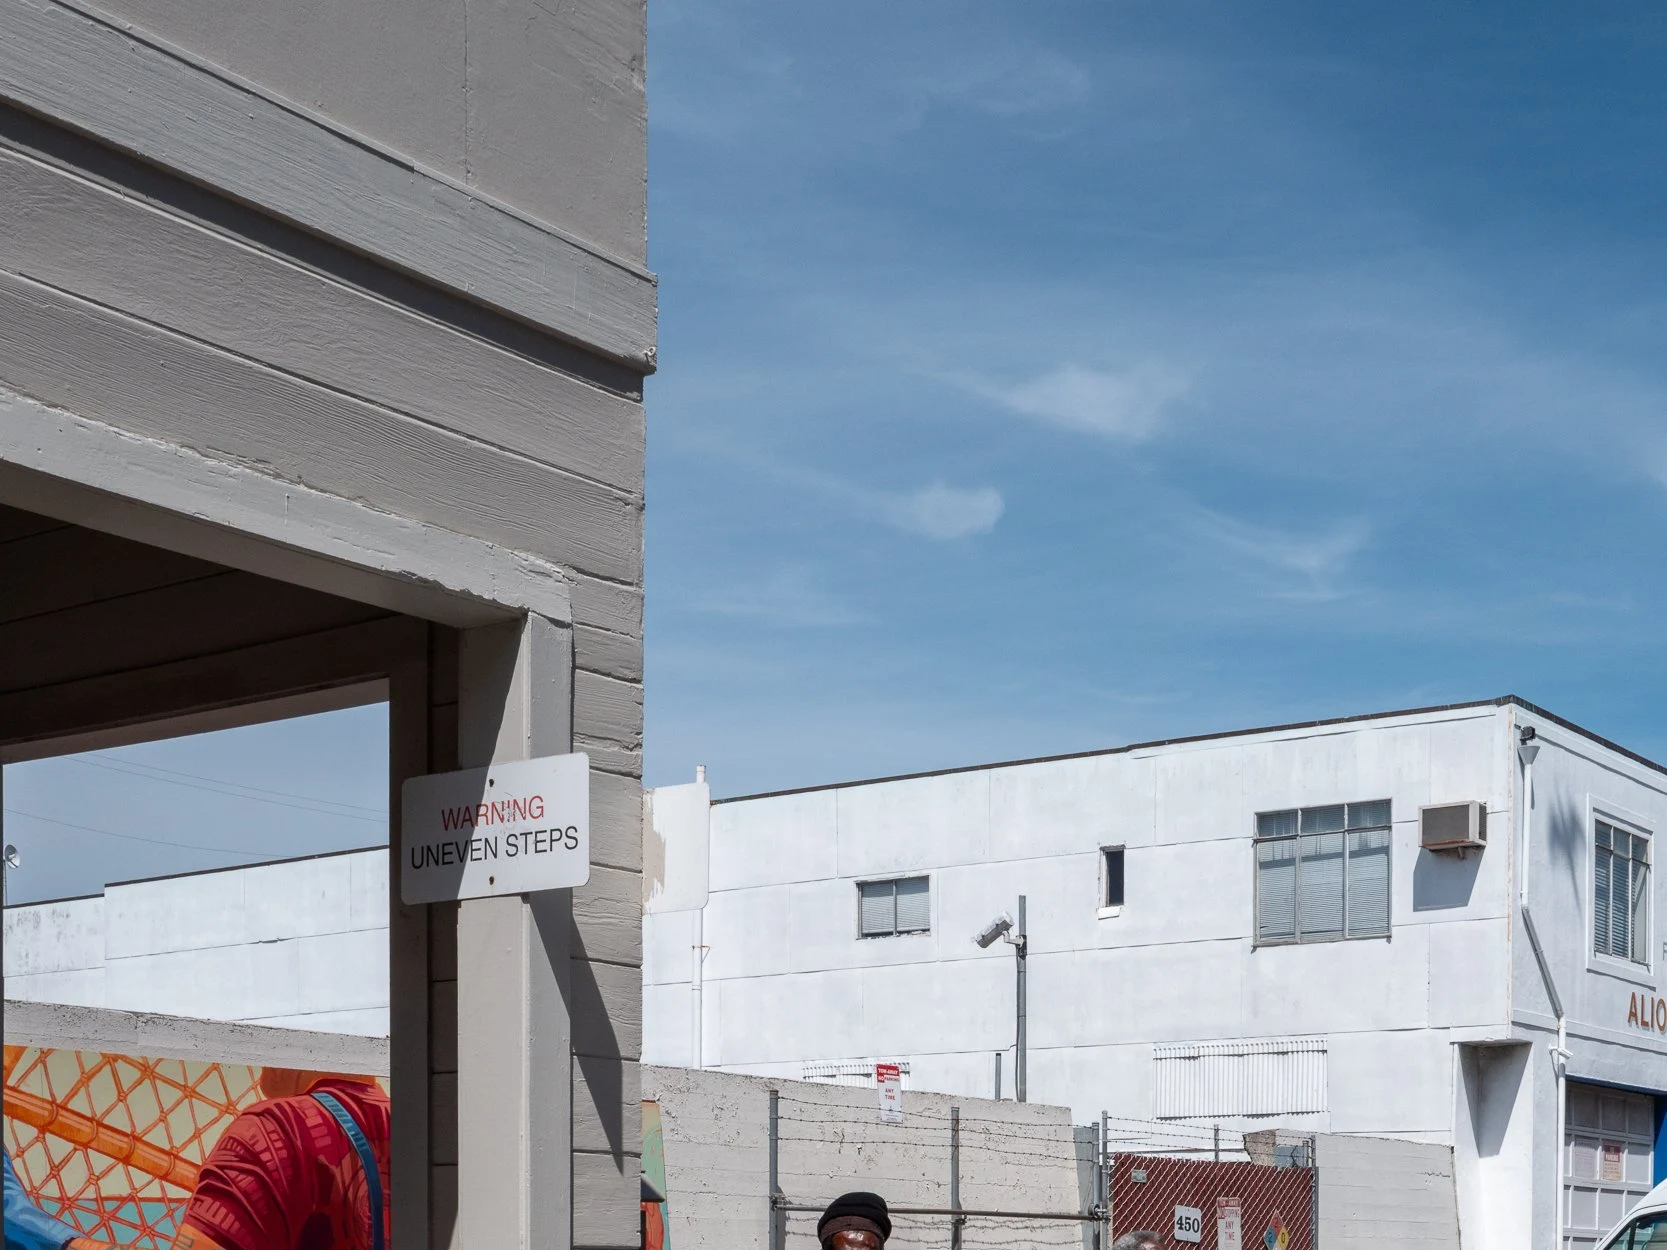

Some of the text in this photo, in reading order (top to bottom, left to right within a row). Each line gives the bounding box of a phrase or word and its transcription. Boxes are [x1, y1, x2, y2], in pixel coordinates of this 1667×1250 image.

[441, 795, 545, 831] WARNING
[411, 826, 579, 869] UNEVEN STEPS
[1176, 1215, 1200, 1233] 450
[1225, 1220, 1234, 1230] ANY
[1225, 1231, 1235, 1241] TIME
